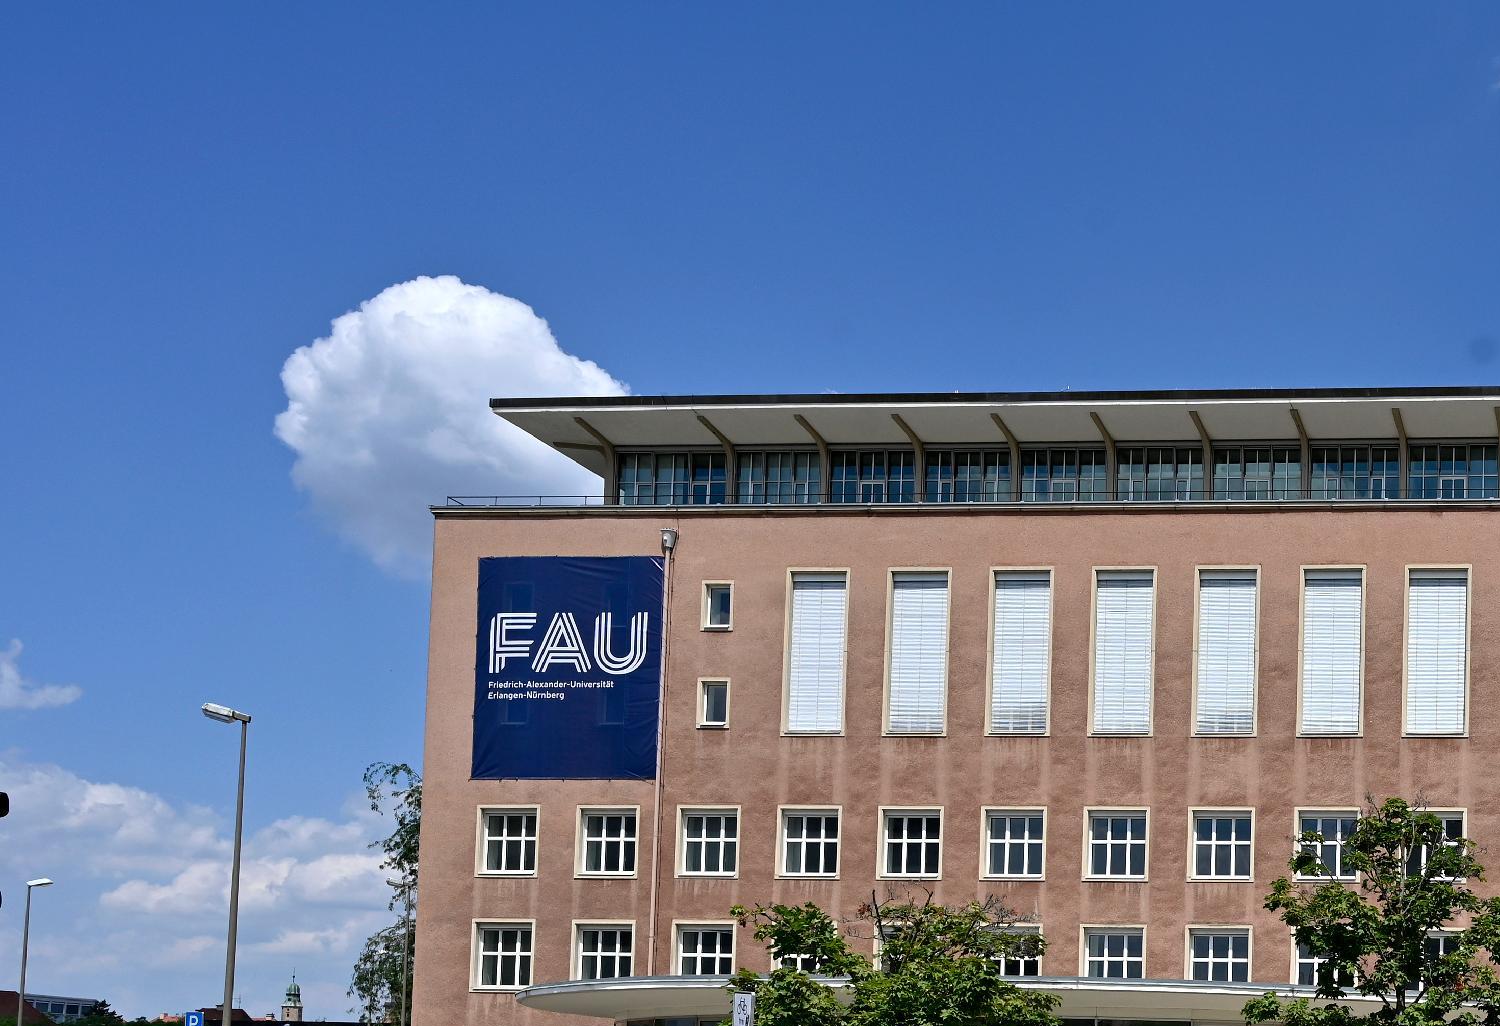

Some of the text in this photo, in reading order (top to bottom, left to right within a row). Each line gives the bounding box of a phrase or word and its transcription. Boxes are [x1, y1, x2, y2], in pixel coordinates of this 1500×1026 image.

[488, 611, 649, 675] FAU
[488, 680, 615, 689] Friedrich-Alexander-Universität
[487, 691, 566, 701] Erlangen-Nürnberg
